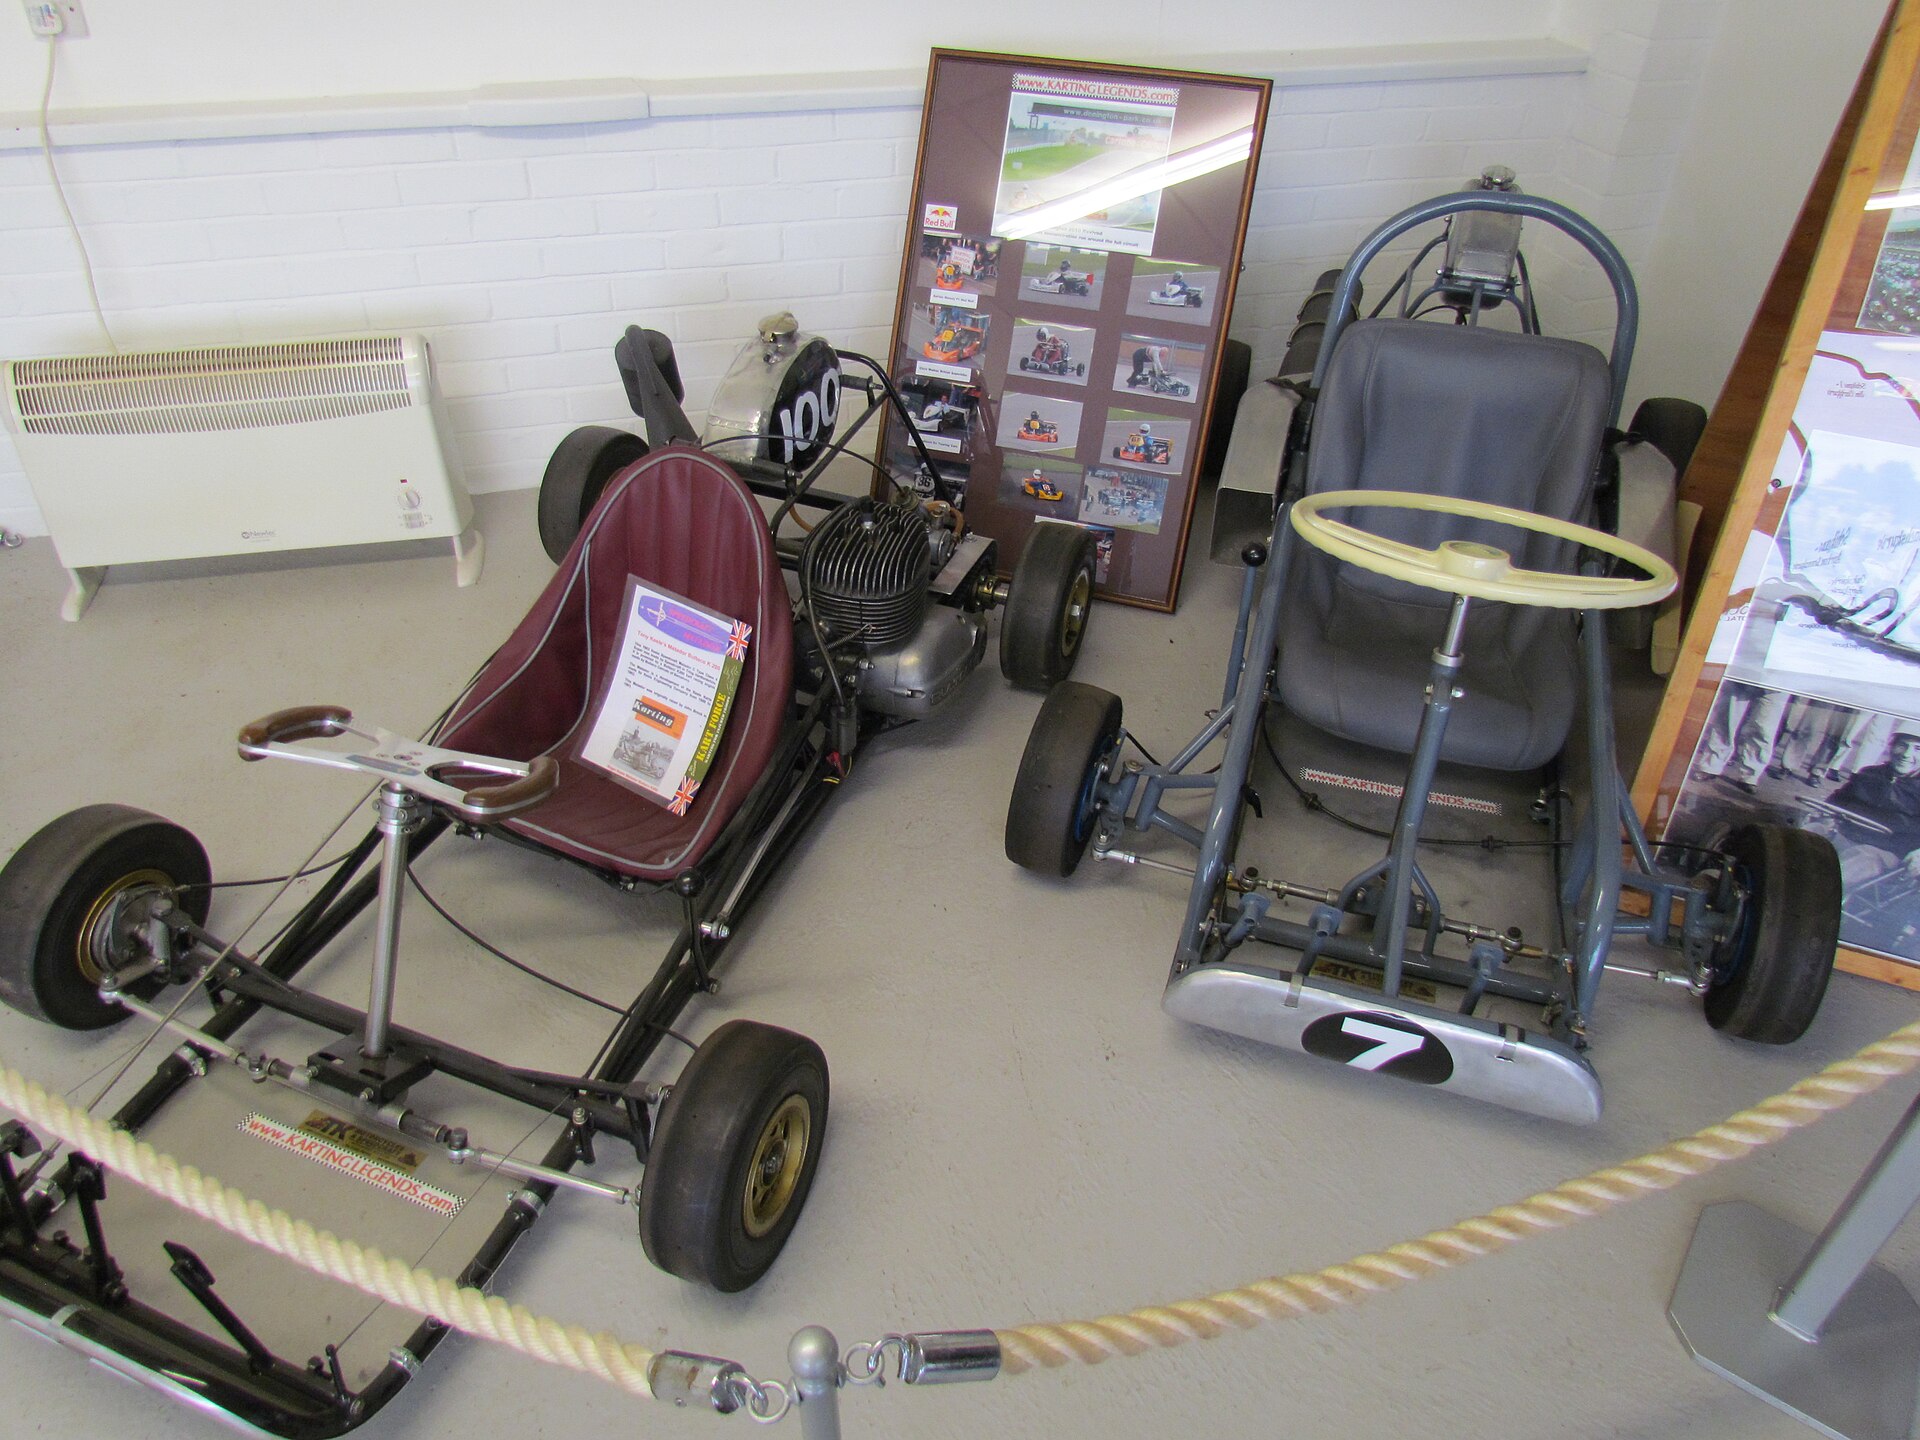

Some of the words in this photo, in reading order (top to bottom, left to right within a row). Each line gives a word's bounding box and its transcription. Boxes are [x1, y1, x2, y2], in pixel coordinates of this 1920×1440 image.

[925, 218, 939, 226] Red
[940, 220, 954, 228] Bull
[780, 368, 840, 463] 100
[918, 476, 931, 488] 36
[634, 701, 674, 727] Karting
[695, 729, 715, 761] KART
[708, 692, 727, 728] FORCE
[1307, 772, 1496, 812] www.KARTINGENDS.com
[1341, 1017, 1424, 1070] 7
[248, 1119, 454, 1211] www.KARTINGLEGENDS.com
